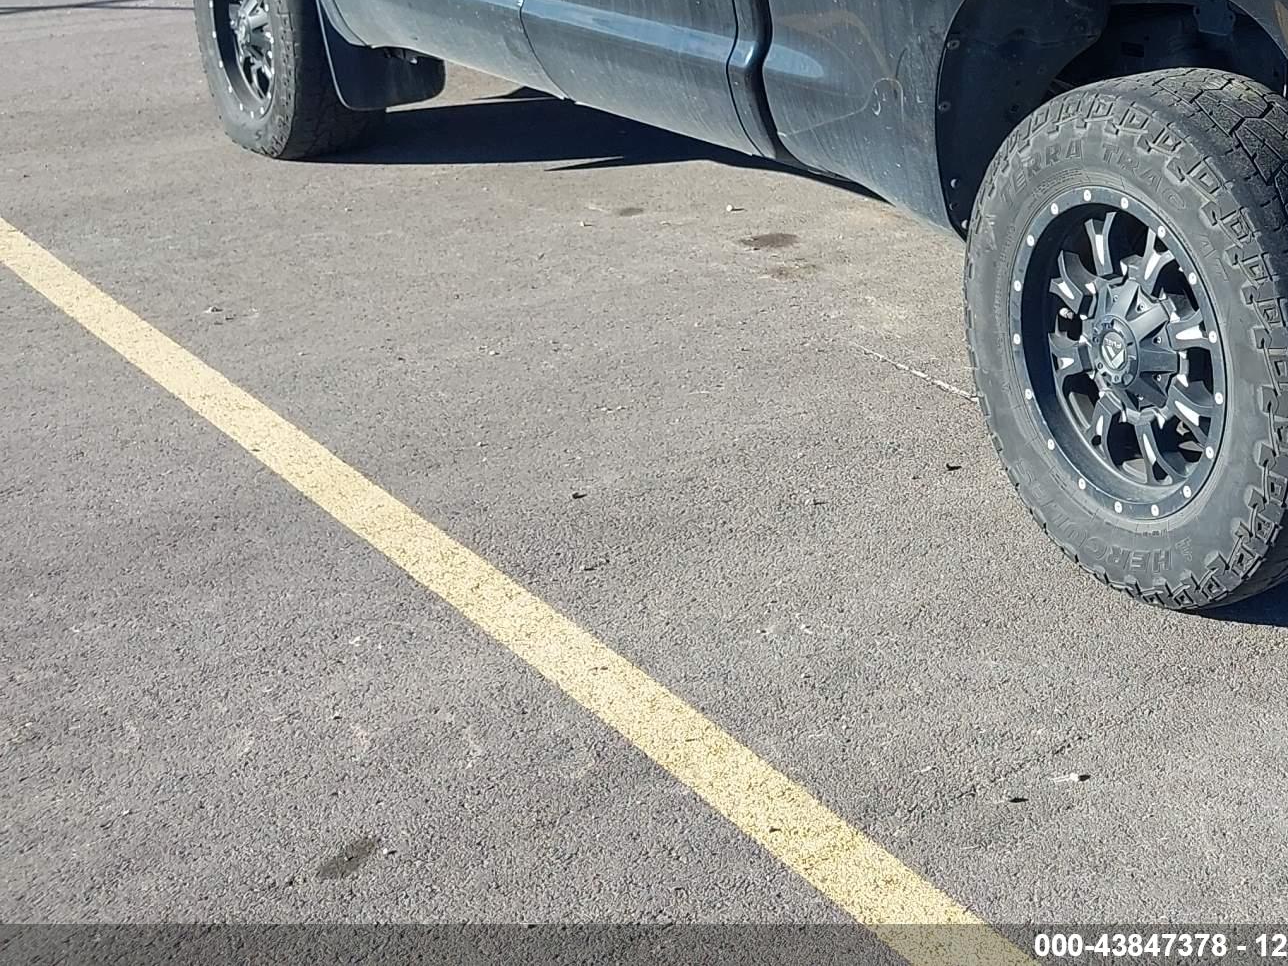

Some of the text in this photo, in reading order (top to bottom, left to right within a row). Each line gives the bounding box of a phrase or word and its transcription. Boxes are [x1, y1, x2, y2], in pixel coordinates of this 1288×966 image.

[1000, 139, 1083, 210] TERRA
[1102, 143, 1186, 211] TRAC
[1010, 458, 1172, 573] HERCULES
